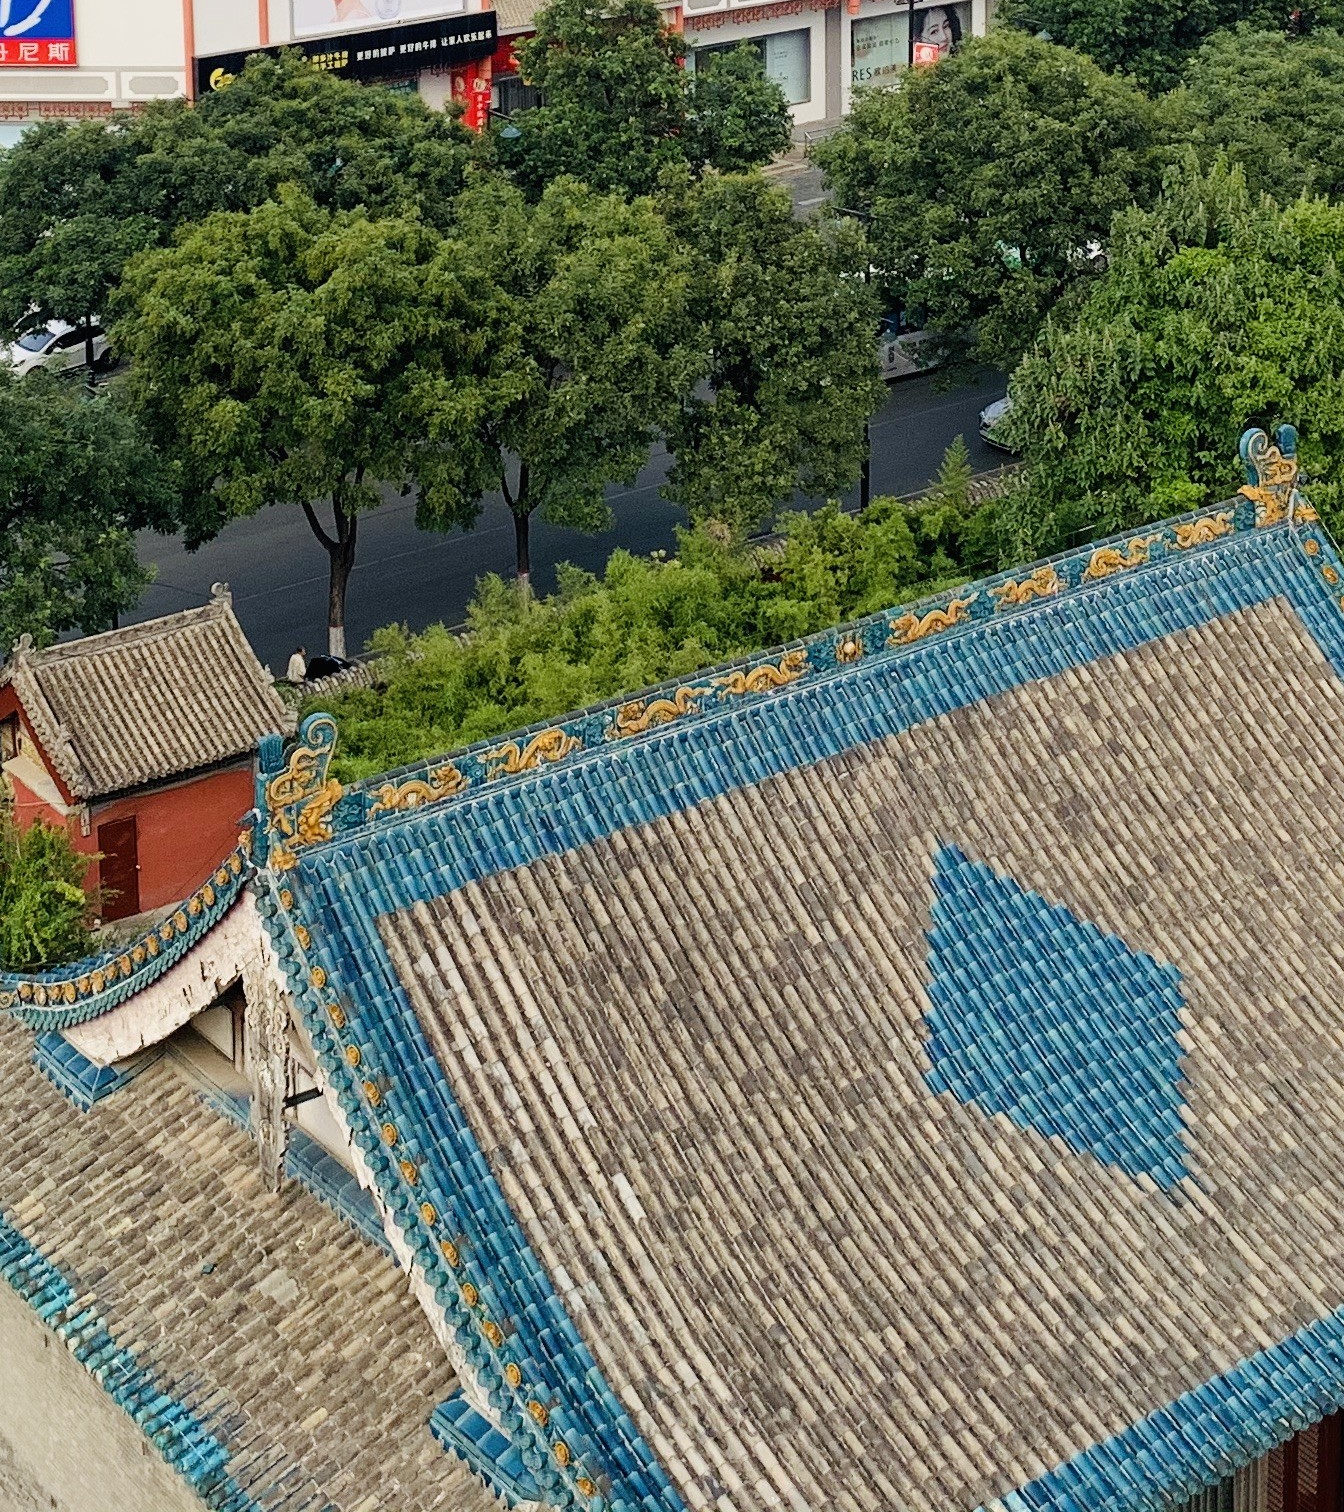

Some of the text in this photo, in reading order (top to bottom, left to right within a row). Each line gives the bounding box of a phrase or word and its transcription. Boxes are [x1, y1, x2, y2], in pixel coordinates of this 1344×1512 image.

[356, 29, 493, 61] 更好的披萨 更好的牛排 让家人欢乐起来
